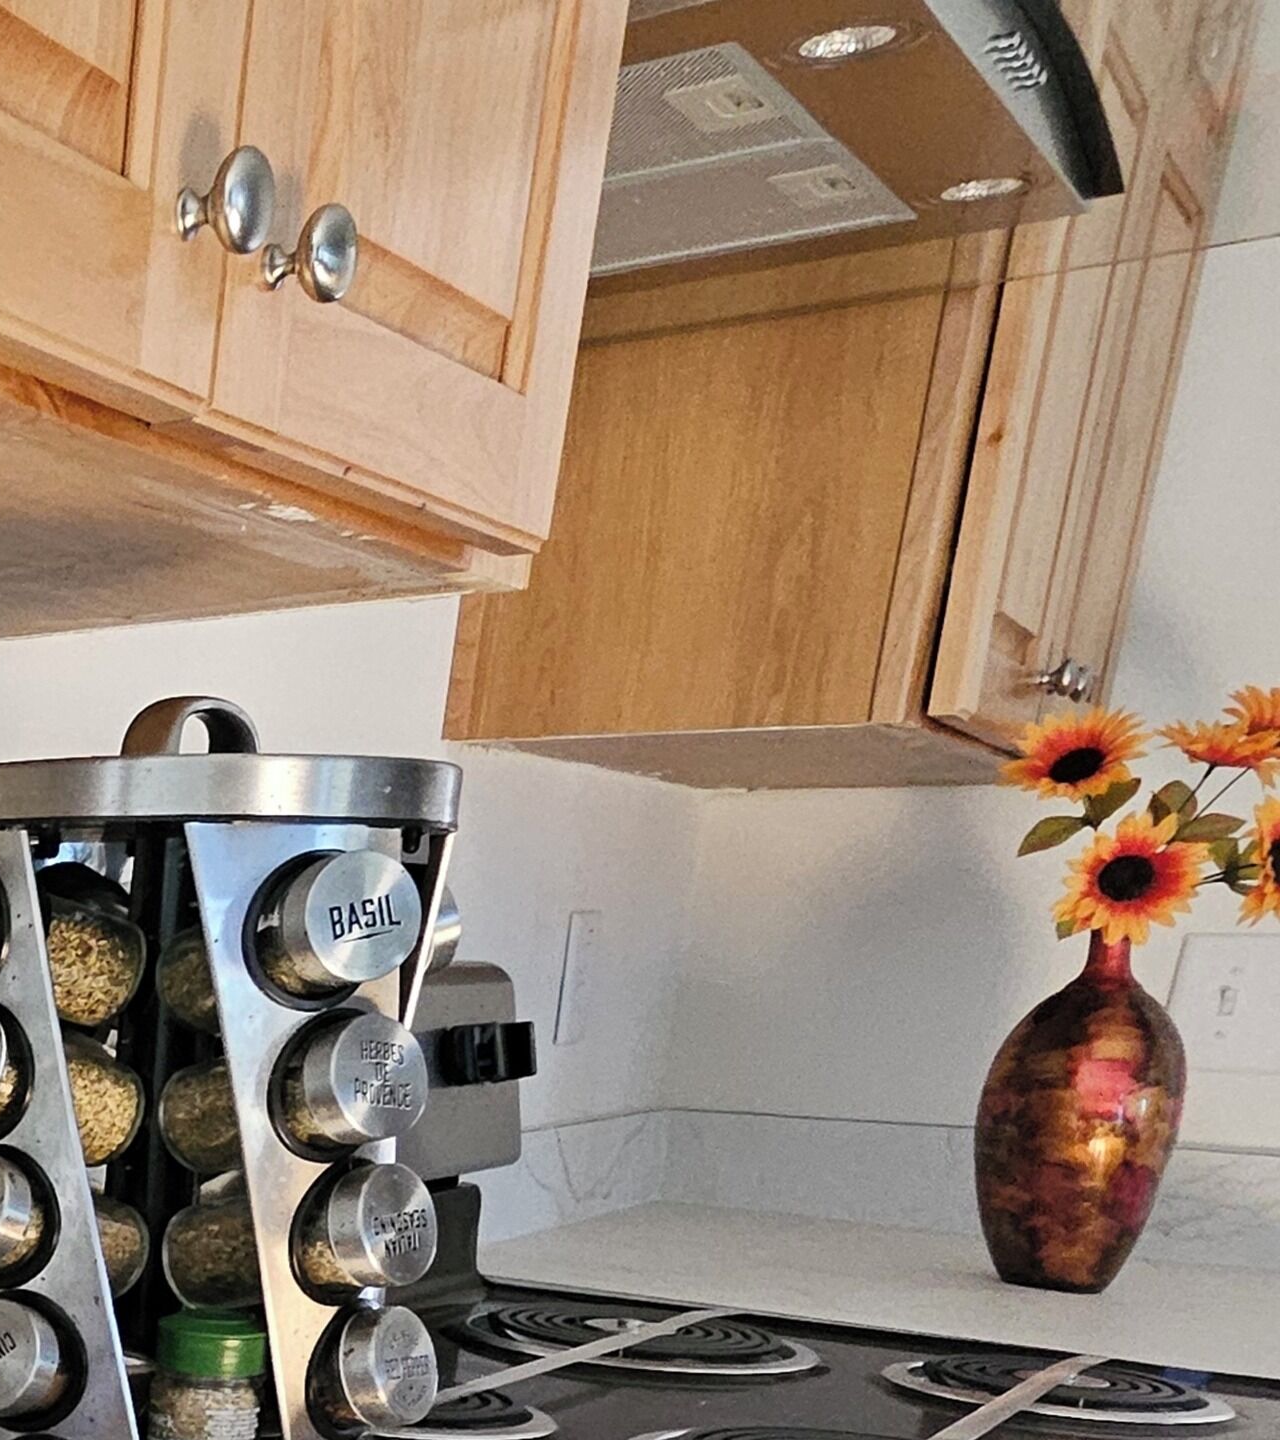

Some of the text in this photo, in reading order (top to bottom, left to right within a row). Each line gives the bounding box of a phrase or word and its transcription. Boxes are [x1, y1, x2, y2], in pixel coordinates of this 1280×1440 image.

[328, 894, 402, 940] BASIL
[361, 1040, 405, 1066] HERBES
[354, 1078, 413, 1109] PROVENCE
